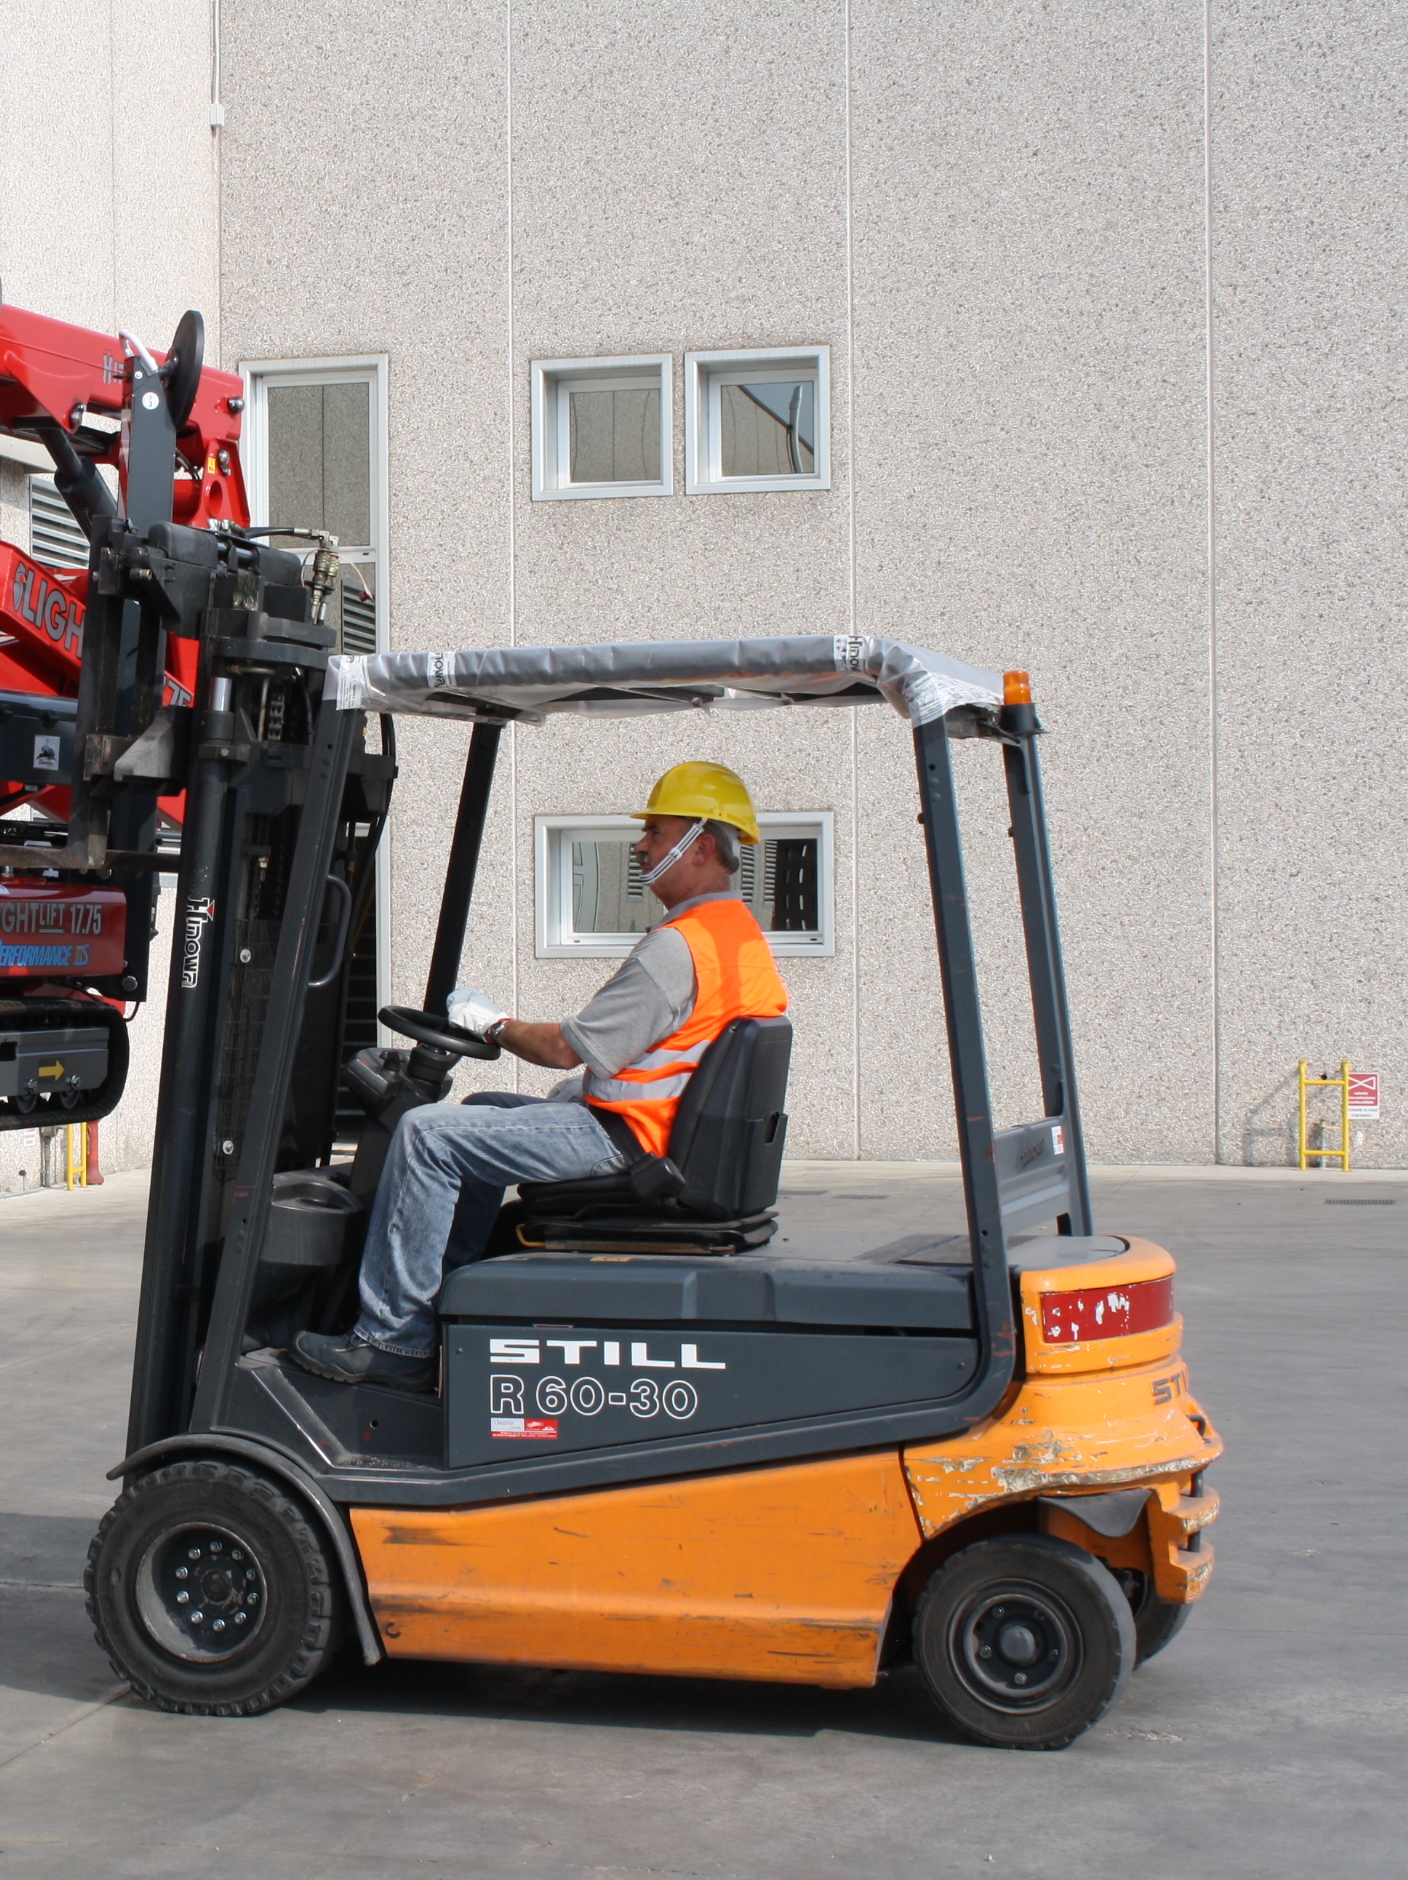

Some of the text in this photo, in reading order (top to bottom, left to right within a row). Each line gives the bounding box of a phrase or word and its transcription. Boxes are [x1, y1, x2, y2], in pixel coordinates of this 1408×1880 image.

[22, 568, 85, 660] LIGH
[70, 903, 102, 935] 17.75
[490, 1339, 726, 1369] STILL
[490, 1374, 698, 1419] R 60-30
